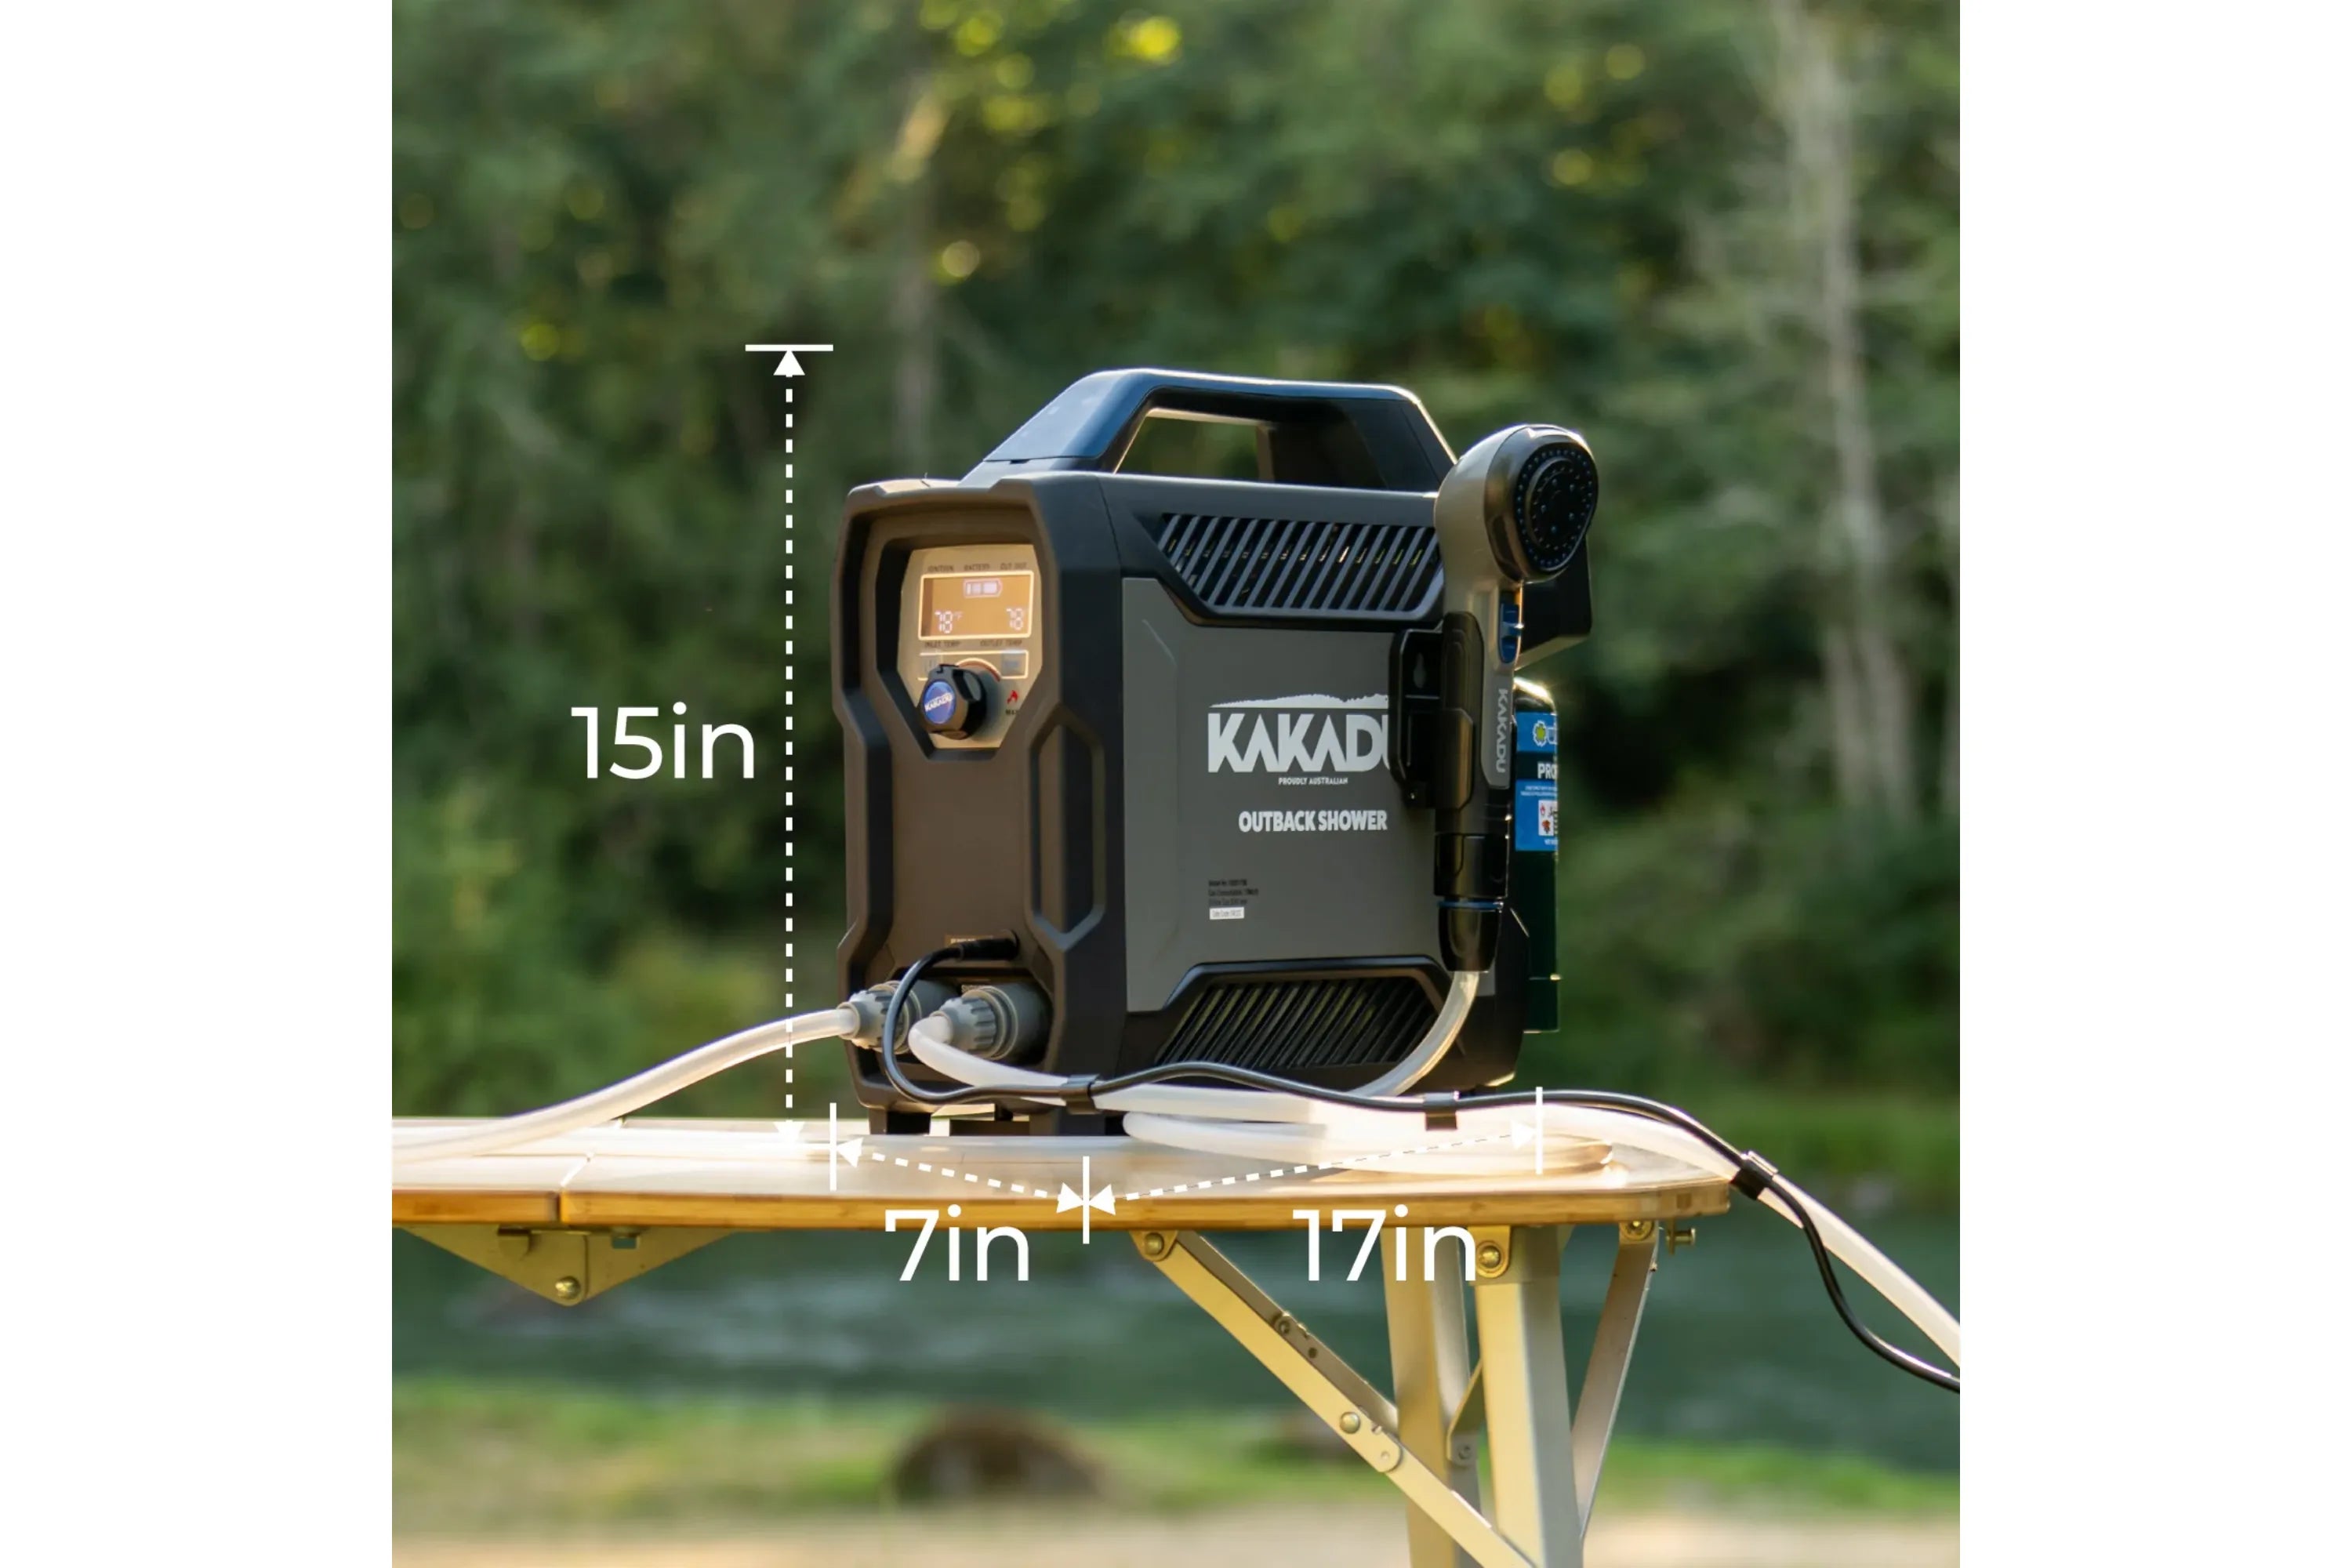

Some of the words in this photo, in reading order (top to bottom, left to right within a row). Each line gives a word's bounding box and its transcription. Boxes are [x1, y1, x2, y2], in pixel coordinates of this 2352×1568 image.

[1496, 688, 1508, 773] KAKADU
[1238, 811, 1316, 832] OUTBACK
[1317, 810, 1388, 831] SHOWER
